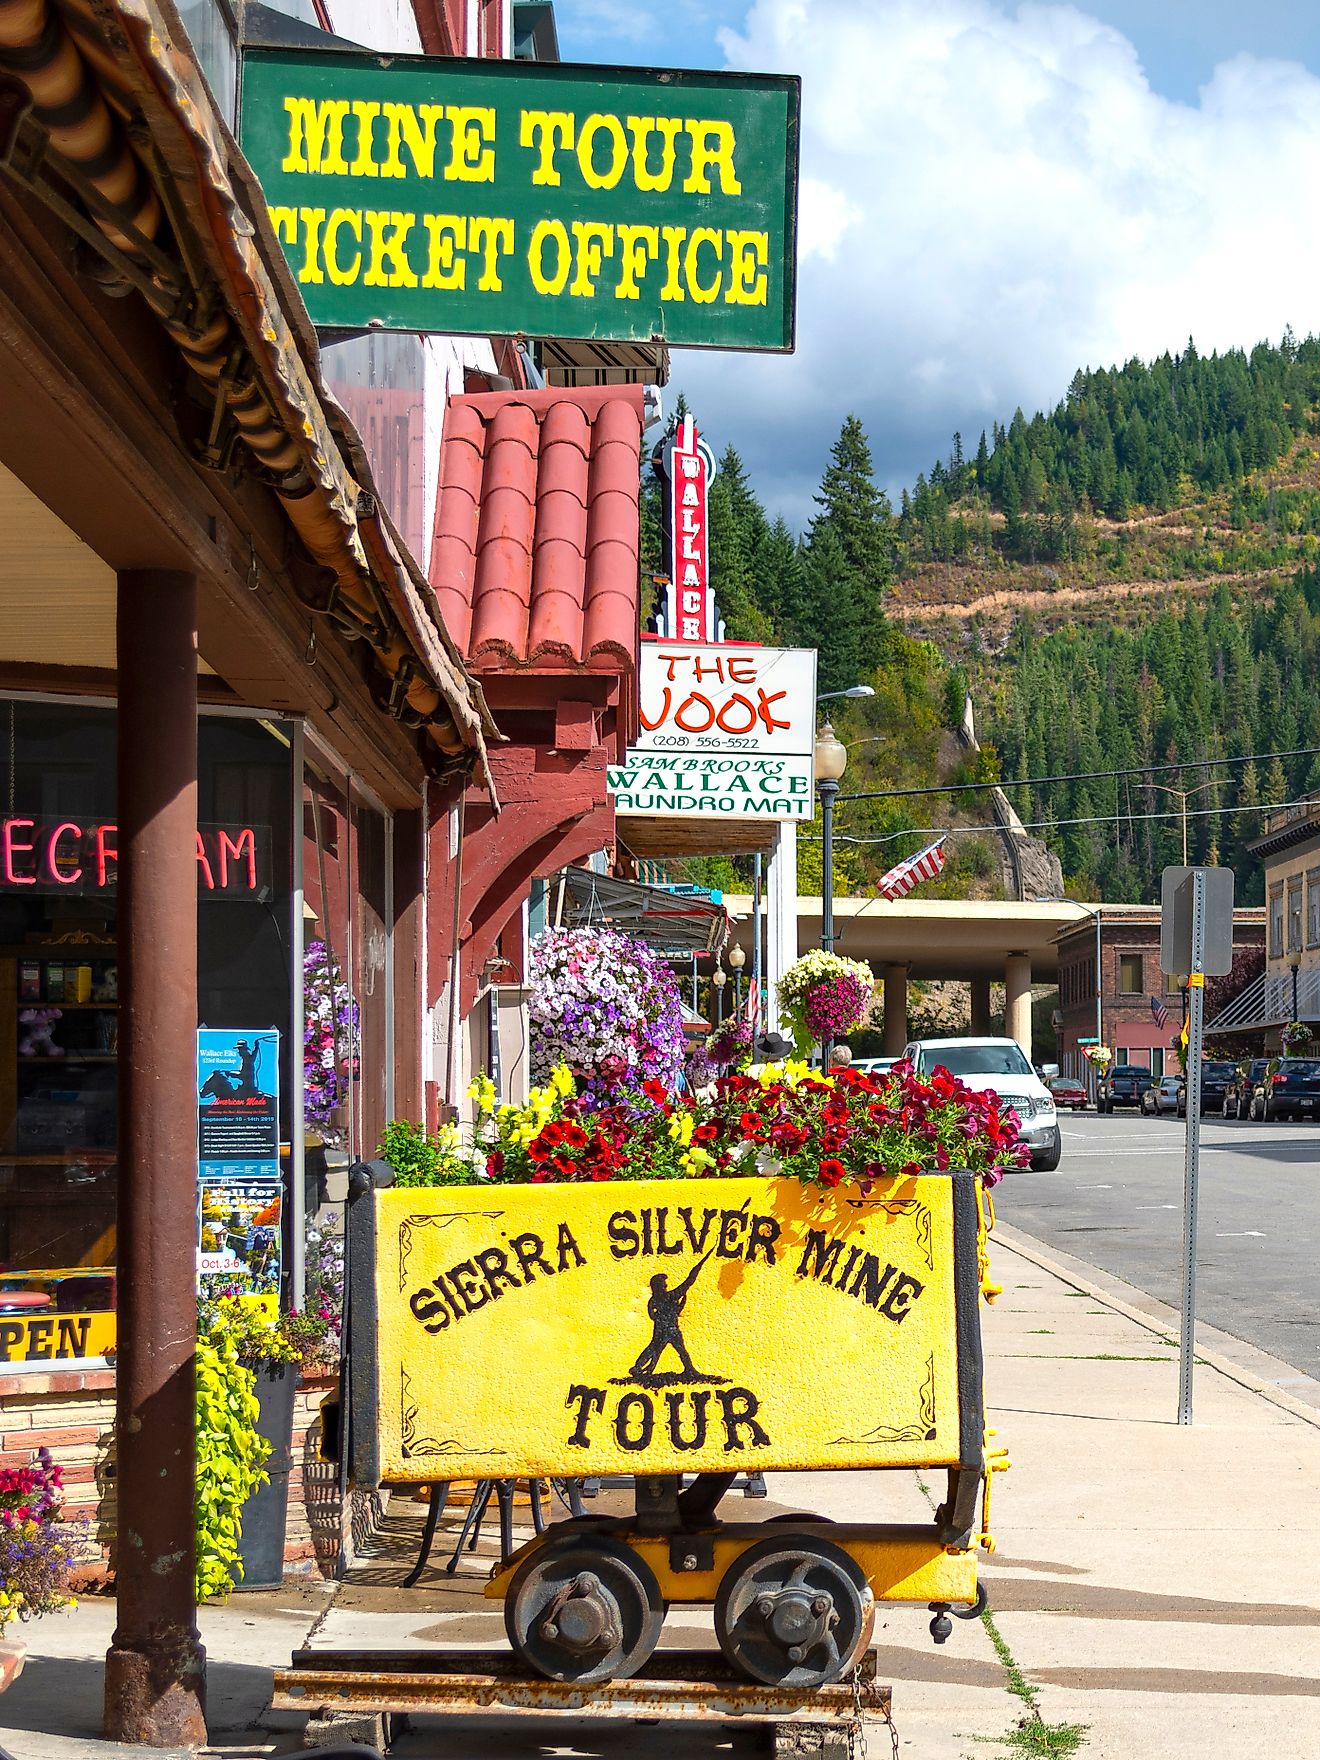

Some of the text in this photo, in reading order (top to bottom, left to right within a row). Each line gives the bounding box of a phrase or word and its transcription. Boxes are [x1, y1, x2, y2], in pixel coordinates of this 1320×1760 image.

[282, 97, 741, 196] MINE TOUR
[527, 219, 769, 306] OFFICE
[681, 455, 700, 642] WALLACE
[658, 655, 757, 684] THE
[653, 735, 760, 749] (208) 556-5522
[624, 756, 786, 776] SAM BROOKS
[607, 771, 809, 794] WALLACE
[615, 793, 809, 813] AUNDRO MAT
[248, 1187, 275, 1197] for
[202, 1260, 222, 1268] Oct.
[408, 1205, 925, 1336] SIERRA SILVER MINE
[0, 1318, 92, 1362] PEN
[564, 1384, 771, 1453] TOUR
